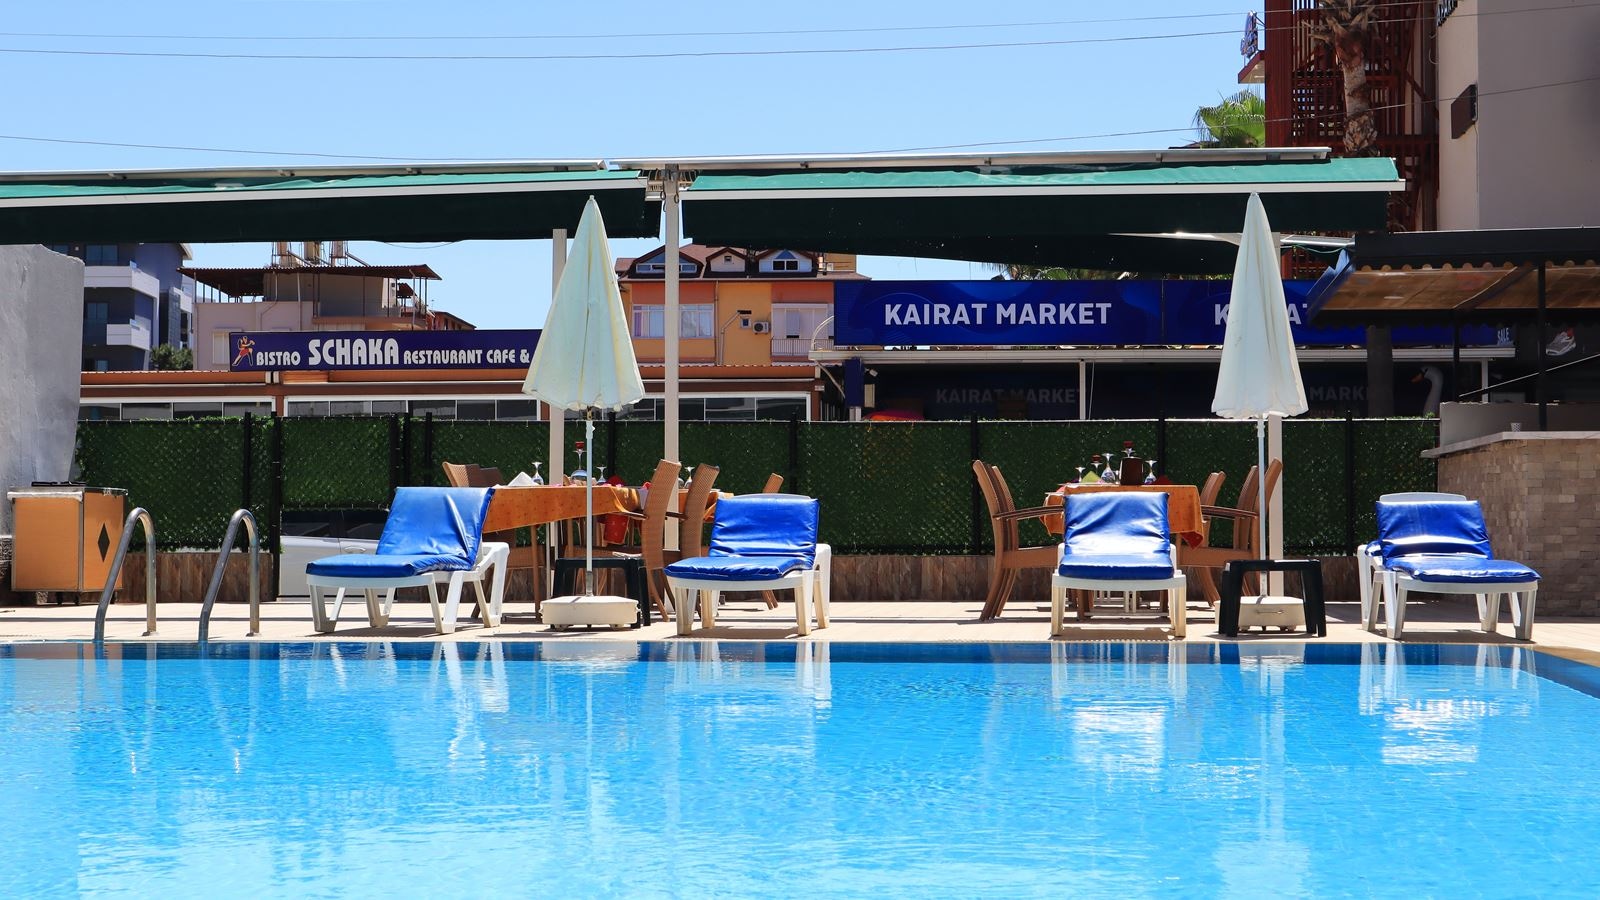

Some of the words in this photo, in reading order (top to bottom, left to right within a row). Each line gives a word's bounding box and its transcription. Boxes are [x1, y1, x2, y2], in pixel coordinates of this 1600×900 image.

[885, 304, 987, 325] KAIRAT
[996, 303, 1112, 325] MARKET
[256, 351, 301, 366] BISTRO
[308, 338, 399, 366] SCHAKA
[403, 349, 483, 365] RESTAURANT
[486, 349, 516, 364] CAFE
[519, 348, 530, 363] &
[935, 388, 1004, 403] KAIRAT
[1008, 388, 1080, 403] MARKE
[1309, 386, 1368, 401] MARK
